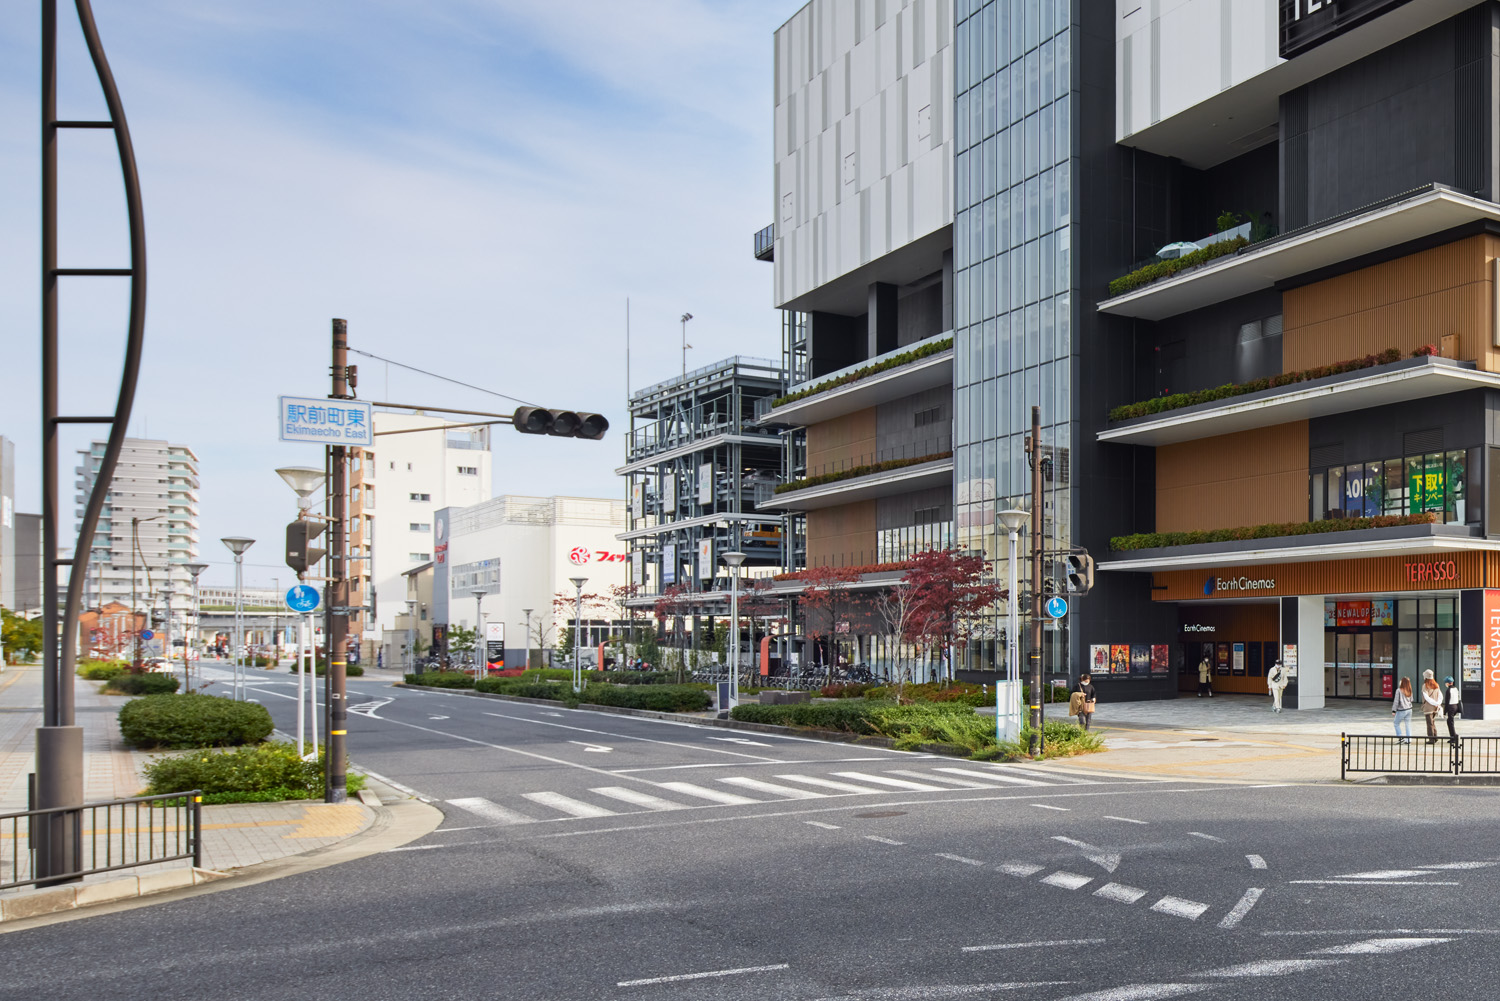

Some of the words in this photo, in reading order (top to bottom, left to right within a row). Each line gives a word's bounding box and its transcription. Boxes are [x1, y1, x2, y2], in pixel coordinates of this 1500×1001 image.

[287, 404, 366, 427] 駅前町東
[286, 423, 341, 437] Ekimaecho
[345, 428, 367, 439] East
[1414, 492, 1445, 502] キャンペー
[596, 551, 629, 562] フィッ
[1405, 561, 1455, 581] TERASSO
